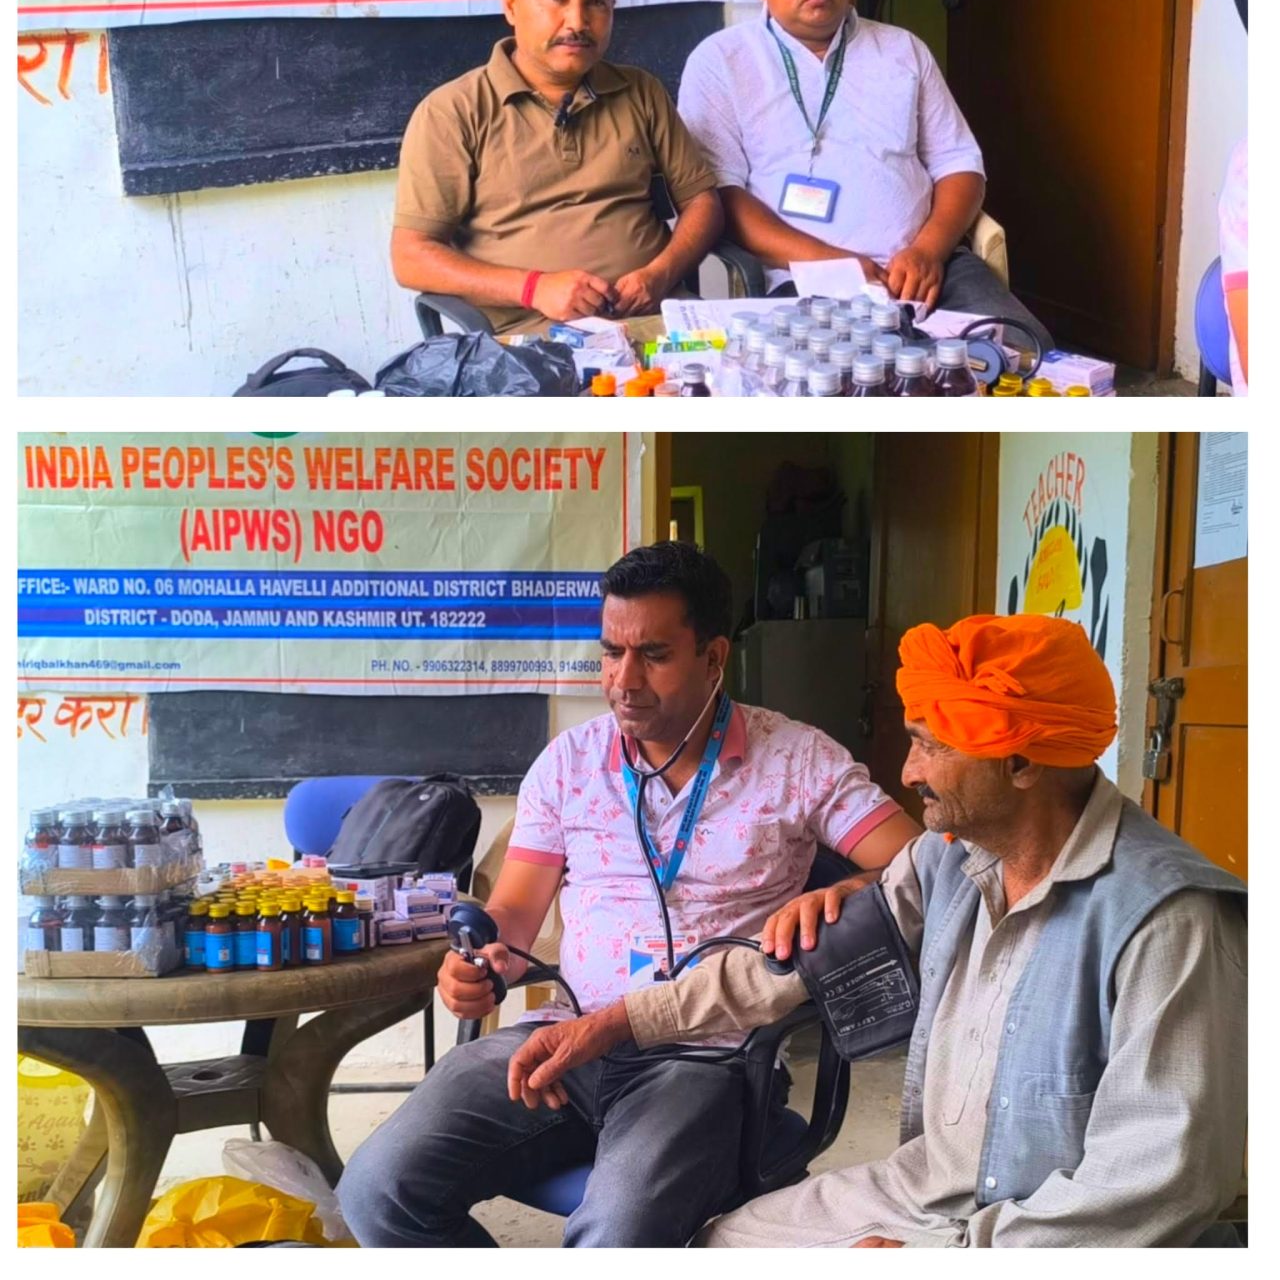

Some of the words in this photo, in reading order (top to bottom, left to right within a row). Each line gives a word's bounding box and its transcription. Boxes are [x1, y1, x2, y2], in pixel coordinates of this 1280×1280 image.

[25, 445, 113, 489] INDIA
[121, 446, 296, 491] PEOPLES'S
[303, 447, 455, 491] WELFARE
[466, 447, 607, 491] SOCIETY
[1023, 452, 1085, 538] TEACHER
[180, 508, 302, 564] (AIPWS)
[312, 510, 384, 553] NGO
[73, 578, 119, 595] WARD
[124, 579, 151, 595] NO.
[155, 579, 174, 595] 06
[178, 579, 256, 596] MOHALLA
[260, 580, 327, 596] HAVELLI
[331, 580, 429, 597] ADDITIONAL
[433, 580, 507, 597] DISTRICT
[84, 609, 157, 626] DISTRICT
[171, 610, 218, 629] DODA,
[222, 610, 281, 627] JAMMU
[284, 610, 319, 627] AND
[323, 611, 397, 628] KASHMIR
[401, 611, 426, 628] UT.
[430, 611, 486, 628] 182222
[371, 660, 389, 671] PH.
[393, 660, 413, 671] NO.
[423, 659, 488, 674] 9906322314,
[491, 659, 556, 674] 8899700993,
